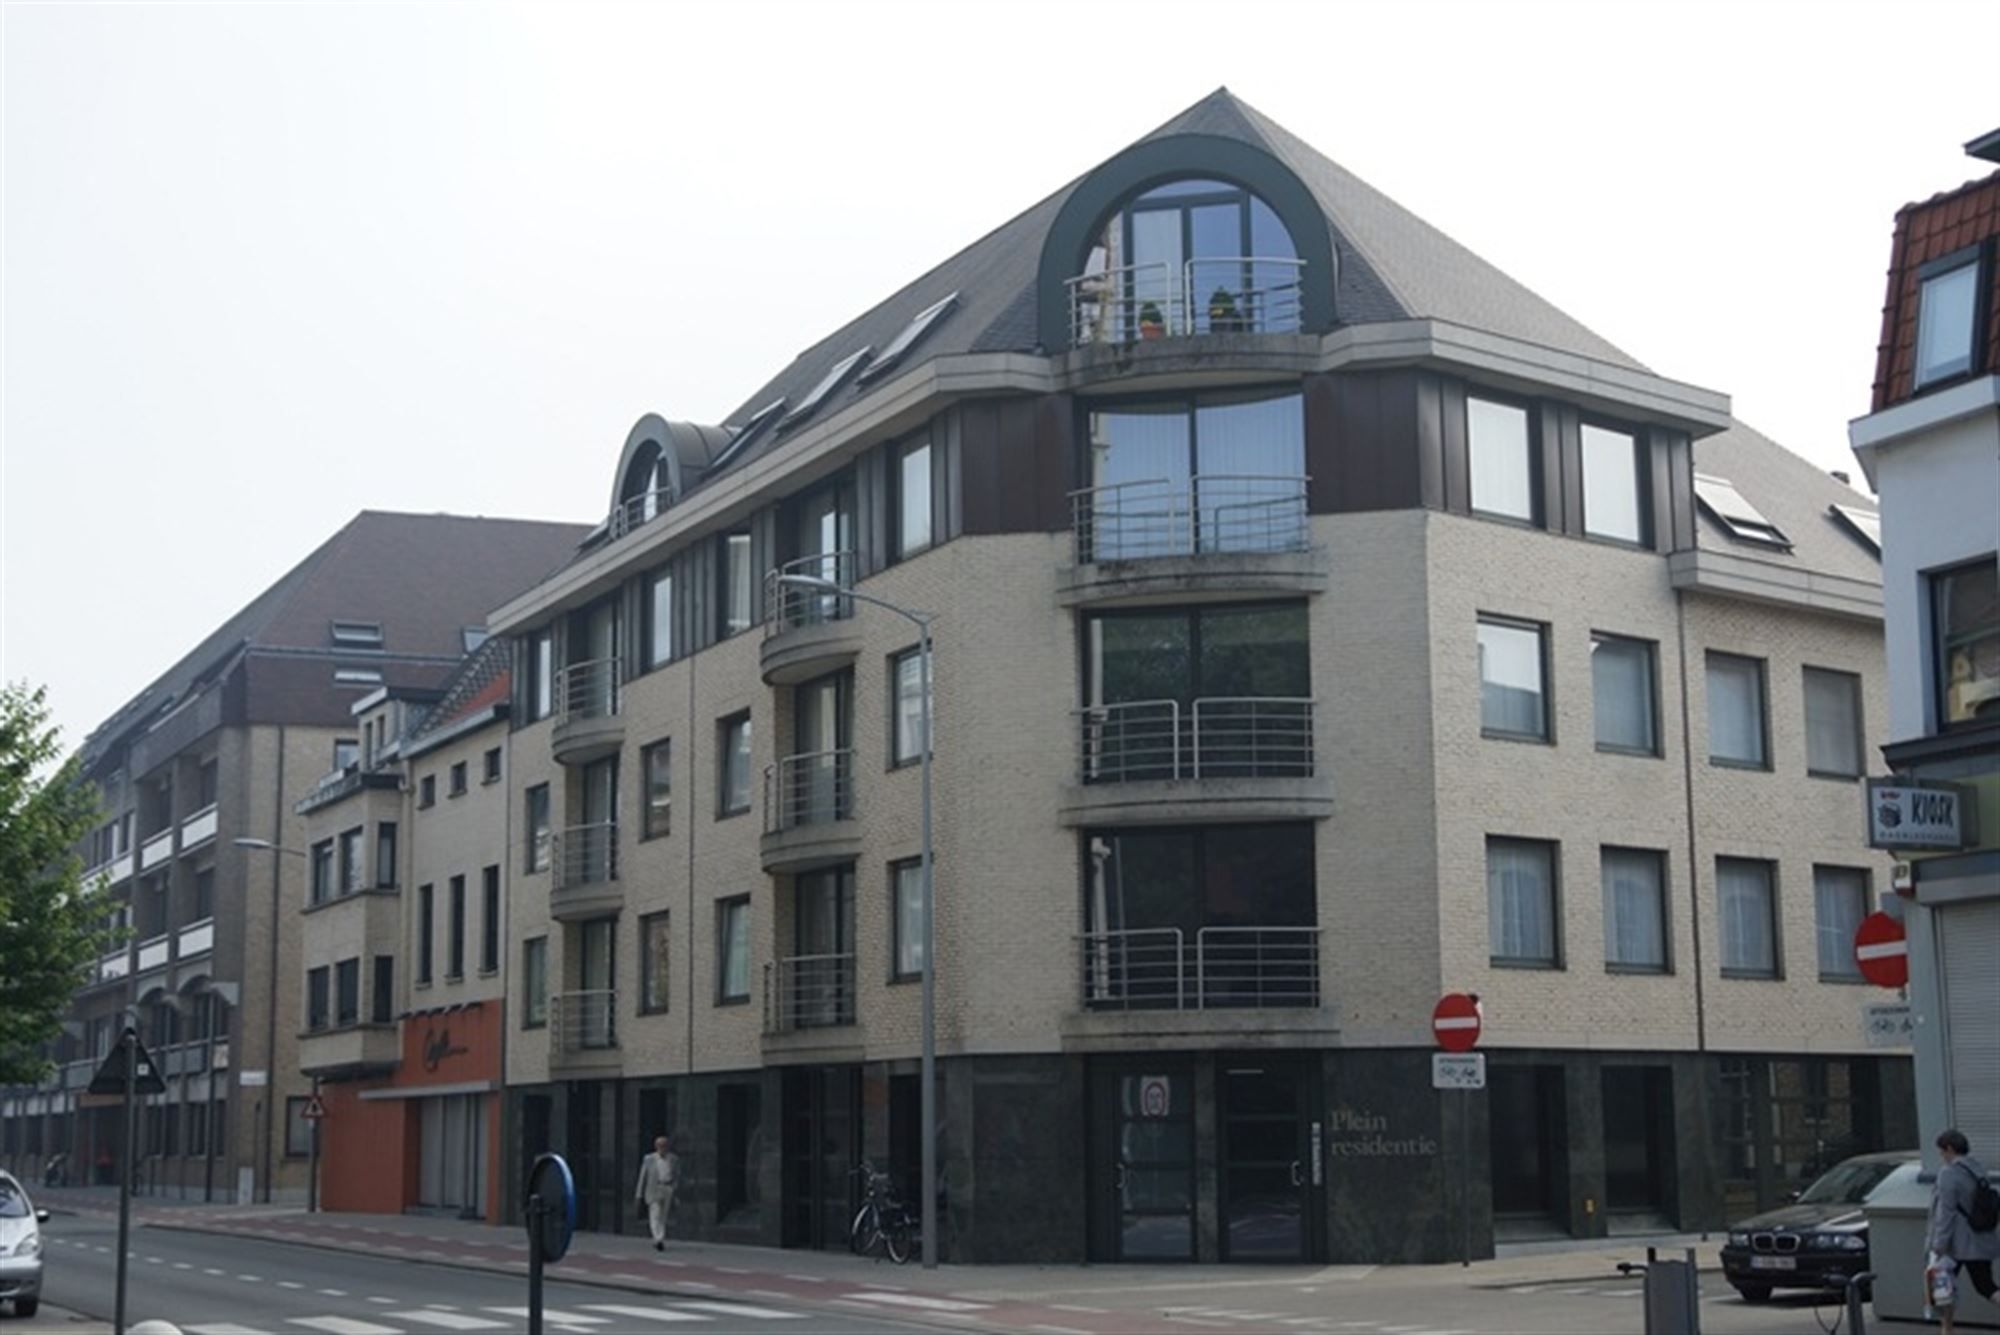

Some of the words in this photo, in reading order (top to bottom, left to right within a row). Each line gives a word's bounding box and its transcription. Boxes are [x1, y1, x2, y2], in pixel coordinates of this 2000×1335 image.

[1912, 792, 1954, 828] KIOSK
[1331, 1110, 1387, 1131] Plein
[1331, 1135, 1437, 1156] residentie
